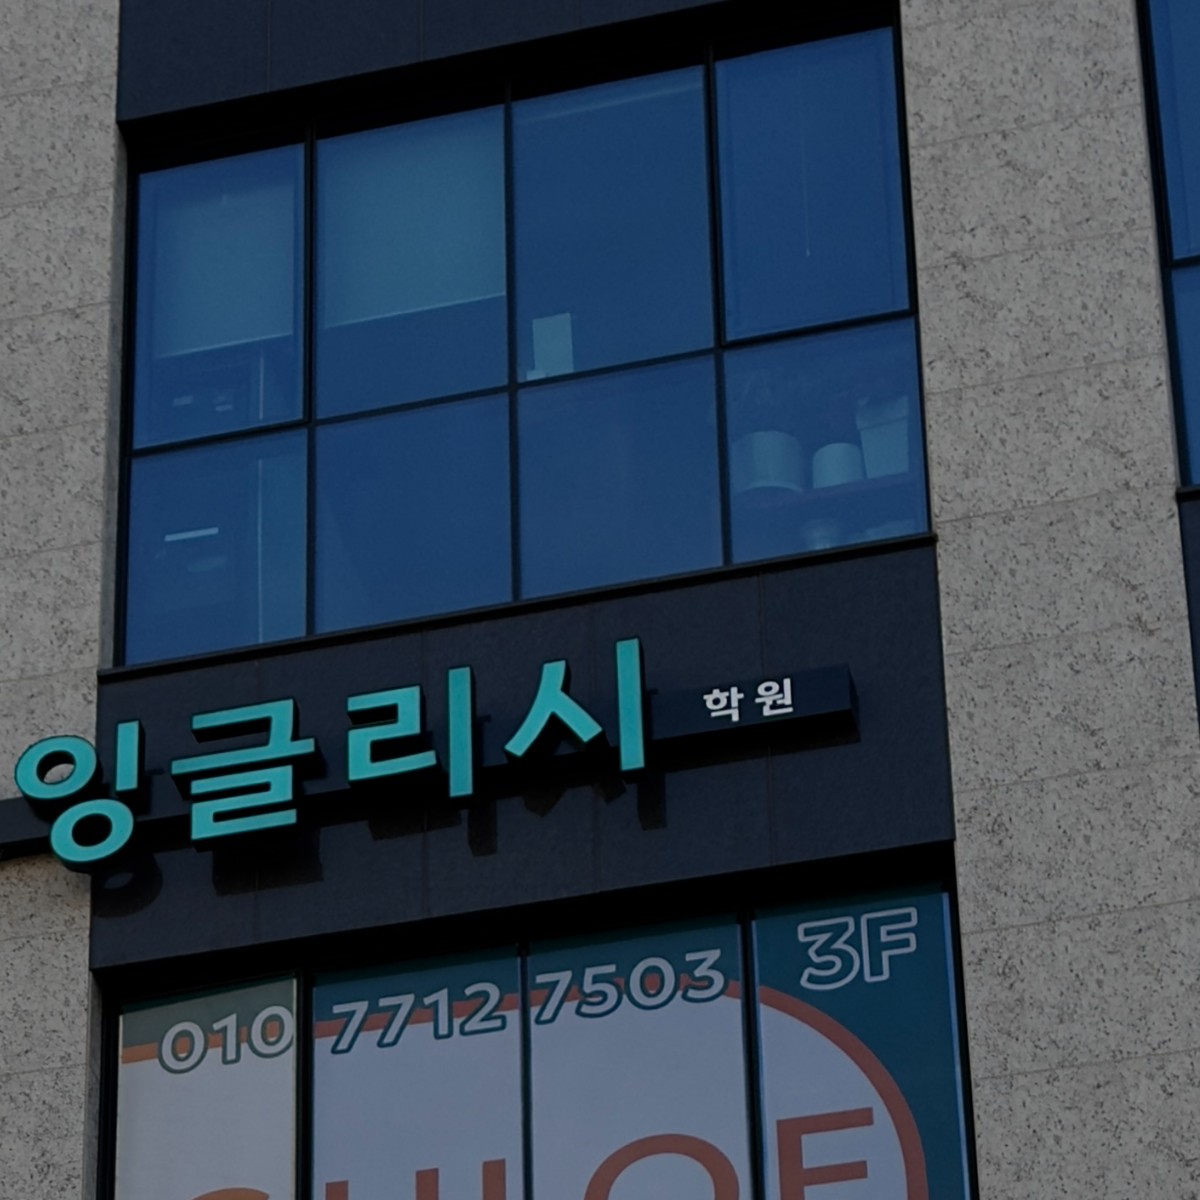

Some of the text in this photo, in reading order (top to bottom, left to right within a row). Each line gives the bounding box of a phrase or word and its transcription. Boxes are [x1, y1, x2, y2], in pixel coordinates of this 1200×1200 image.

[14, 638, 645, 863] 잉글리시
[703, 678, 795, 722] 학원
[798, 907, 918, 991] 3F
[157, 948, 727, 1074] 010 7712 7503
